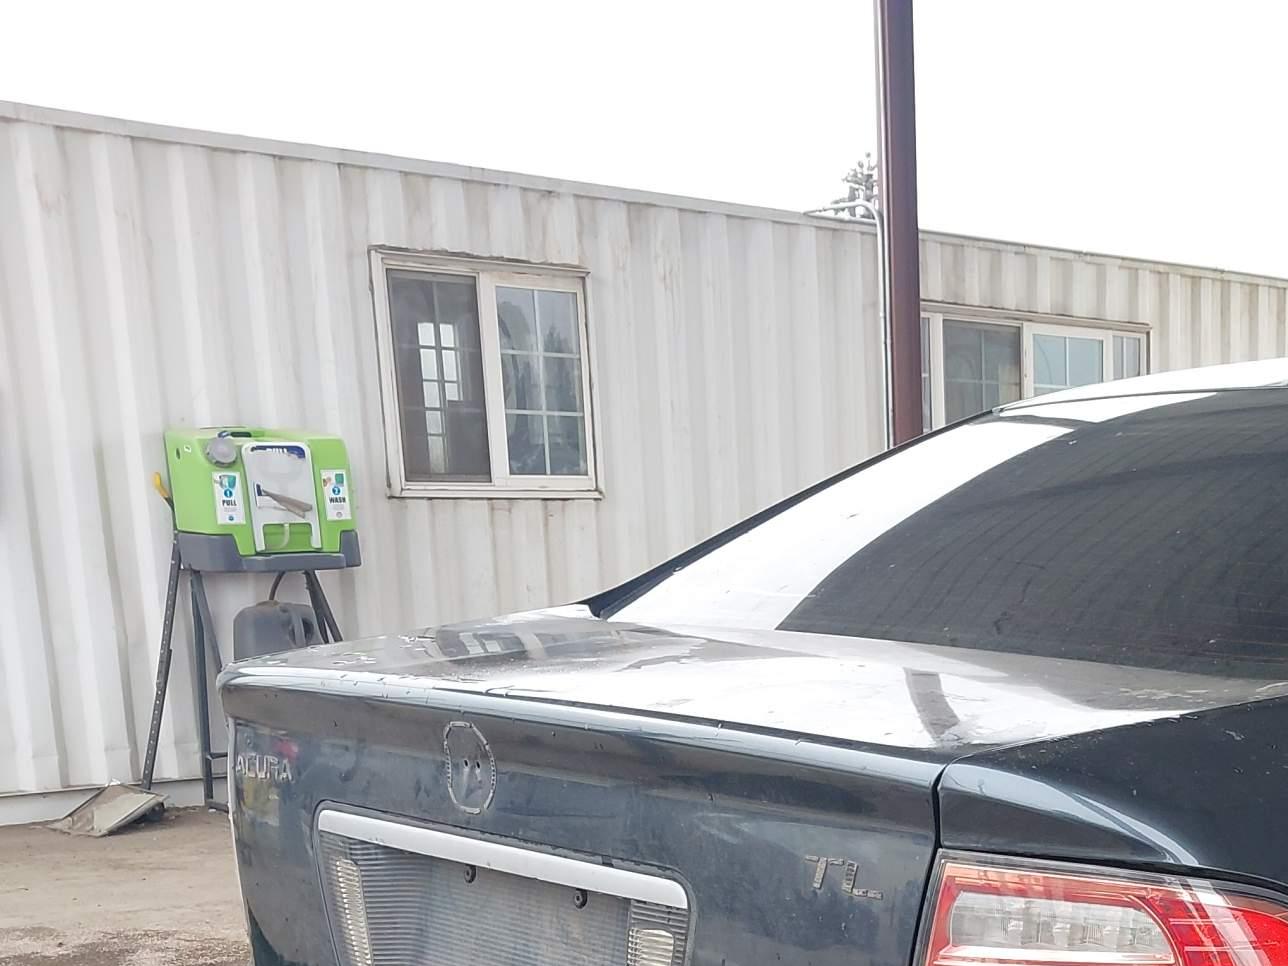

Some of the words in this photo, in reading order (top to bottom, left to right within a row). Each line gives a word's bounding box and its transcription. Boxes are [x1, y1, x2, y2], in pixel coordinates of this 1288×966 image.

[329, 496, 346, 504] WASH
[235, 753, 292, 781] ACURA
[804, 855, 883, 900] TL
